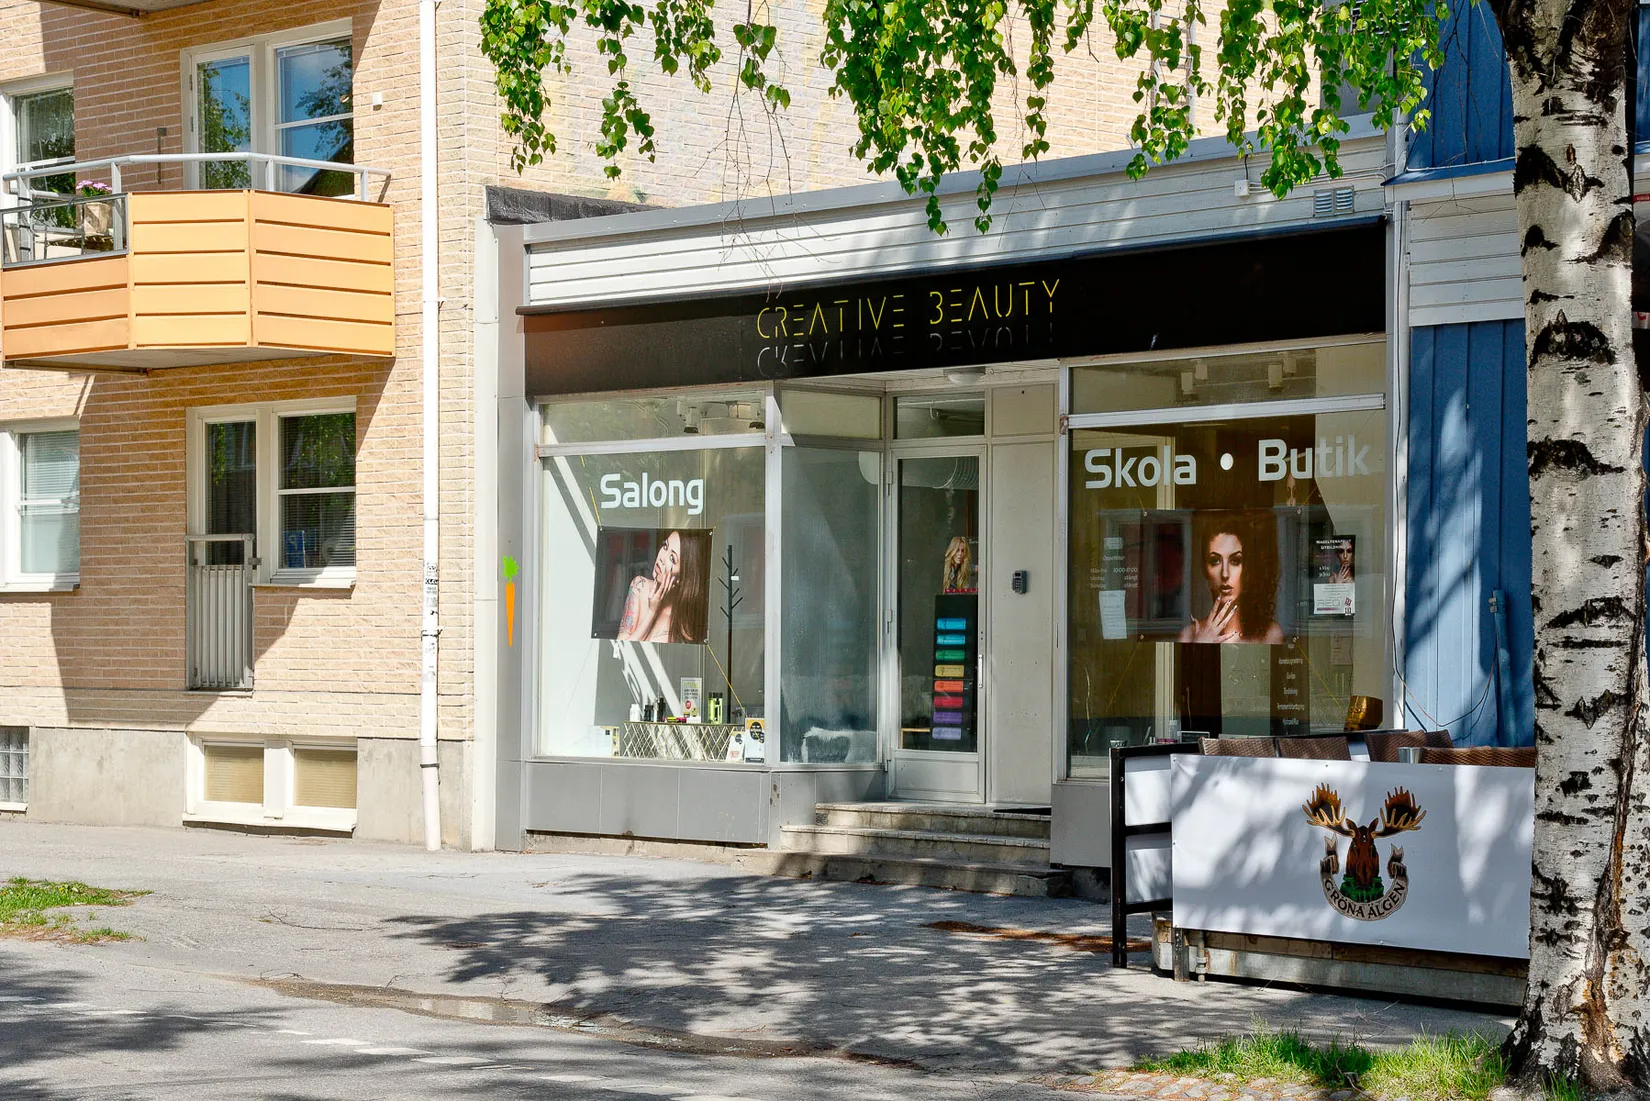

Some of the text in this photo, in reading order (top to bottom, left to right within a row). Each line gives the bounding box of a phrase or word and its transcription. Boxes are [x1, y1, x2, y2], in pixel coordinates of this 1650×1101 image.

[757, 278, 1060, 339] CREATIVE BEAUTY
[1084, 435, 1370, 489] Skola Butik
[600, 472, 704, 515] Salong
[1324, 879, 1405, 919] GRÖNA ÄLGEN
